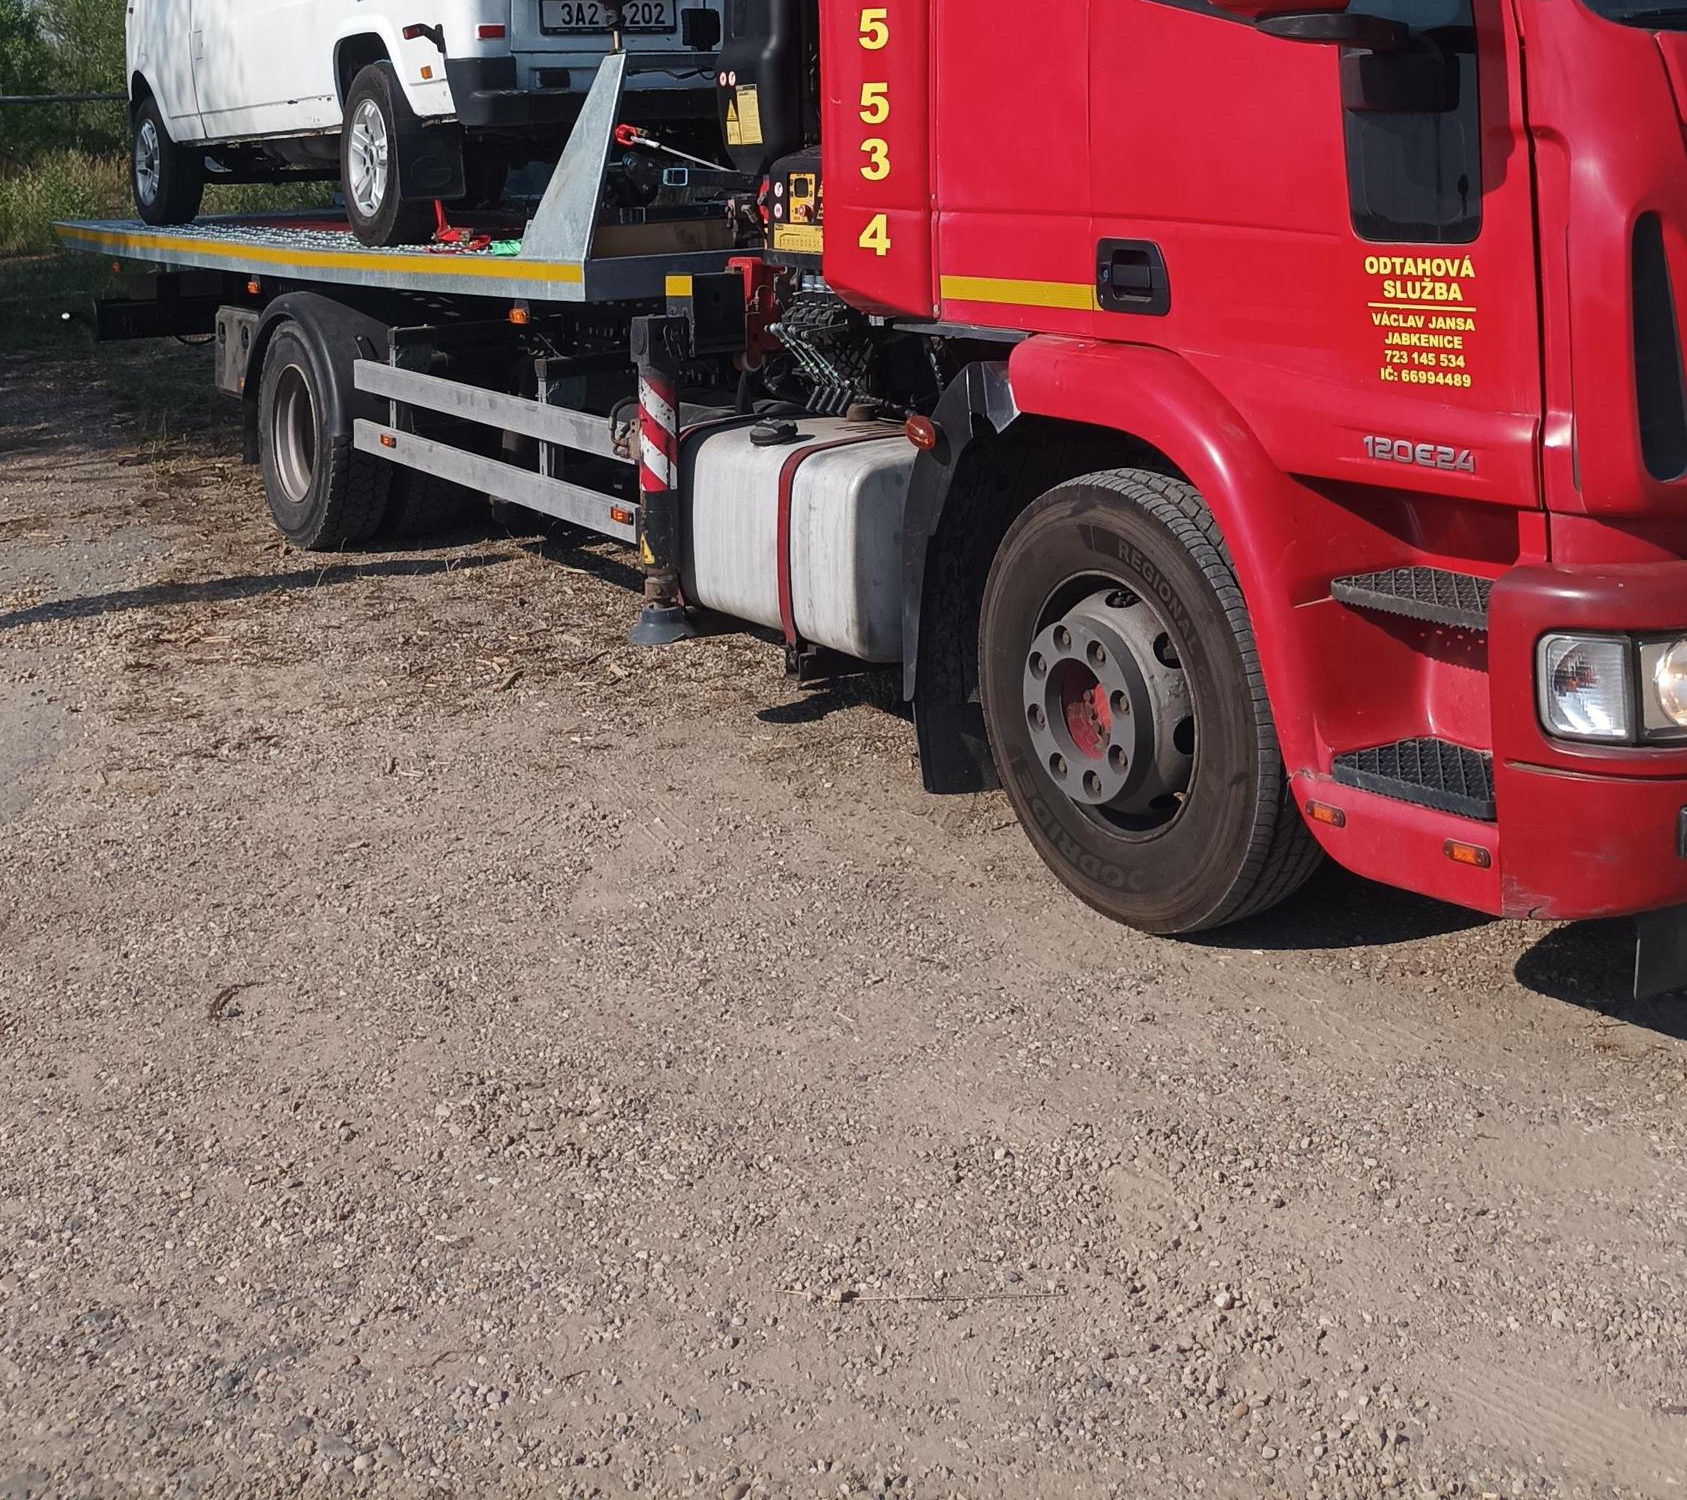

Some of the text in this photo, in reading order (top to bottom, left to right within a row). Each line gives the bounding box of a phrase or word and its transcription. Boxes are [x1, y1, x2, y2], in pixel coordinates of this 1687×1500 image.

[561, 3, 666, 26] 3A2 202
[1364, 255, 1476, 278] ODTAHOVÁ
[1383, 277, 1464, 301] SLUŽBA
[1371, 311, 1476, 331] VÁCLAV JANSA
[1384, 332, 1463, 349] JABKENICE
[1384, 350, 1466, 368] 723 145 534
[1380, 365, 1472, 387] IČ: 66994489
[1363, 435, 1475, 472] 120E24
[1118, 539, 1199, 655] REGIONAL
[1016, 768, 1148, 891] OODRIDE
